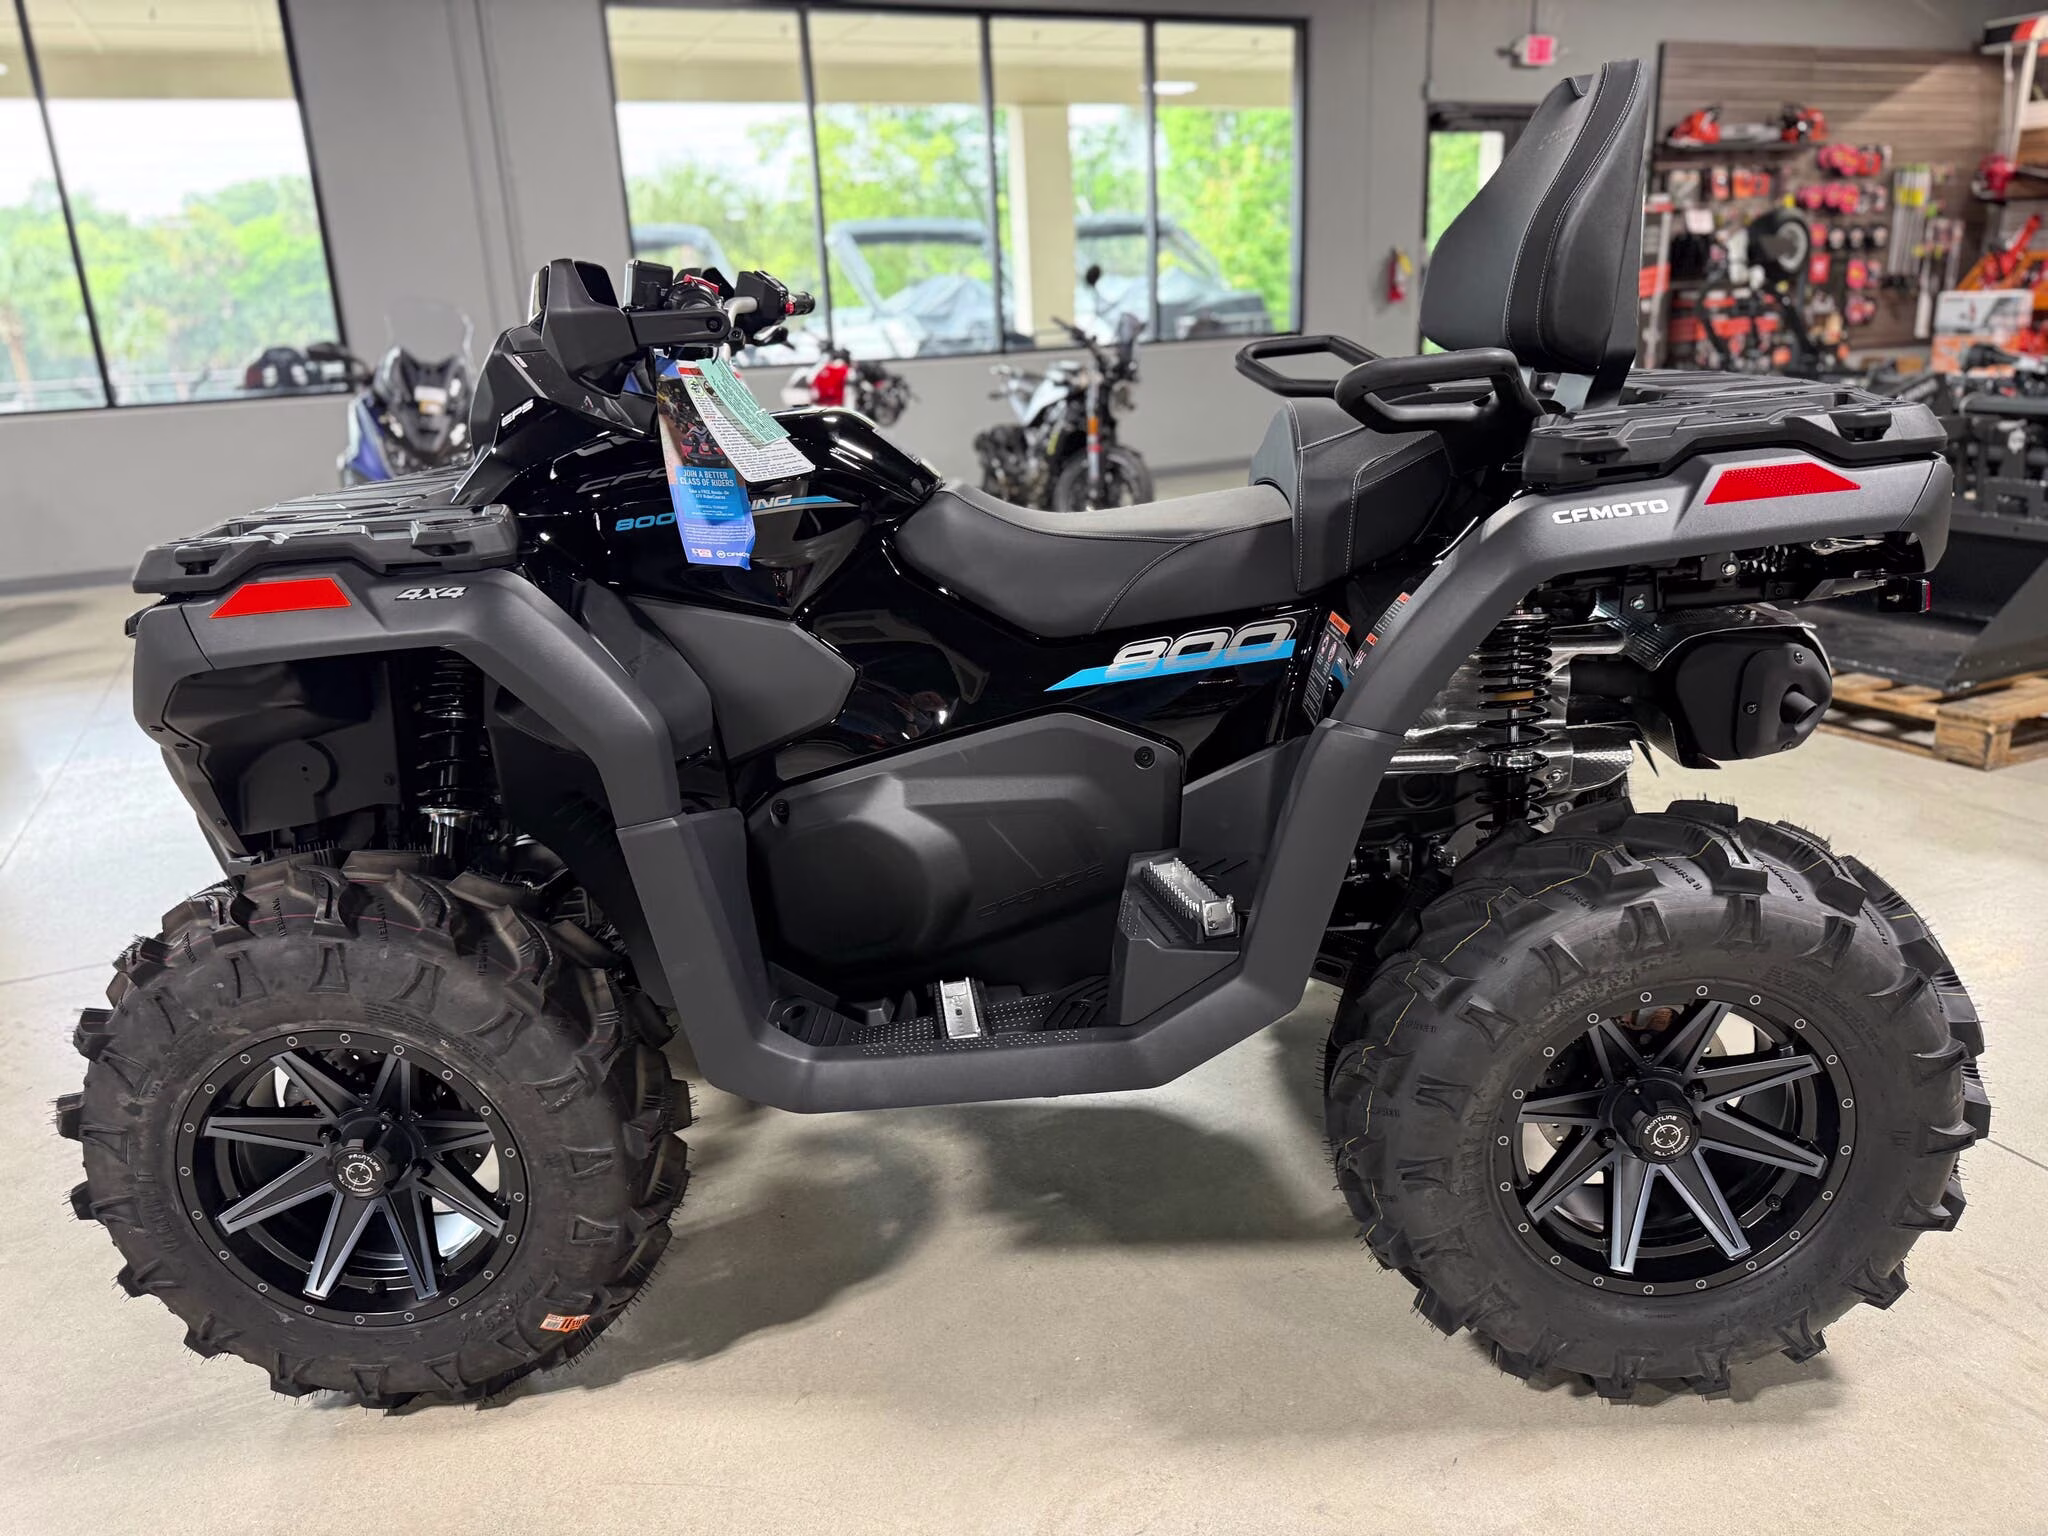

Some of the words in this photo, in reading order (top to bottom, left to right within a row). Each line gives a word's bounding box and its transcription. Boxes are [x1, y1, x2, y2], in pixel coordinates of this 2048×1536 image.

[501, 399, 534, 427] EPS
[679, 477, 701, 486] CLASS
[701, 478, 711, 486] OF
[711, 479, 735, 487] RIDERS
[683, 469, 698, 477] JOIN
[698, 470, 705, 479] A
[704, 471, 729, 479] BETTER
[615, 511, 676, 532] 800
[751, 495, 792, 511] ING
[1552, 499, 1669, 524] CFMOTO
[1105, 619, 1297, 680] 800
[1644, 1114, 1678, 1135] FRONTLINE
[348, 1153, 381, 1172] FRONTLINE
